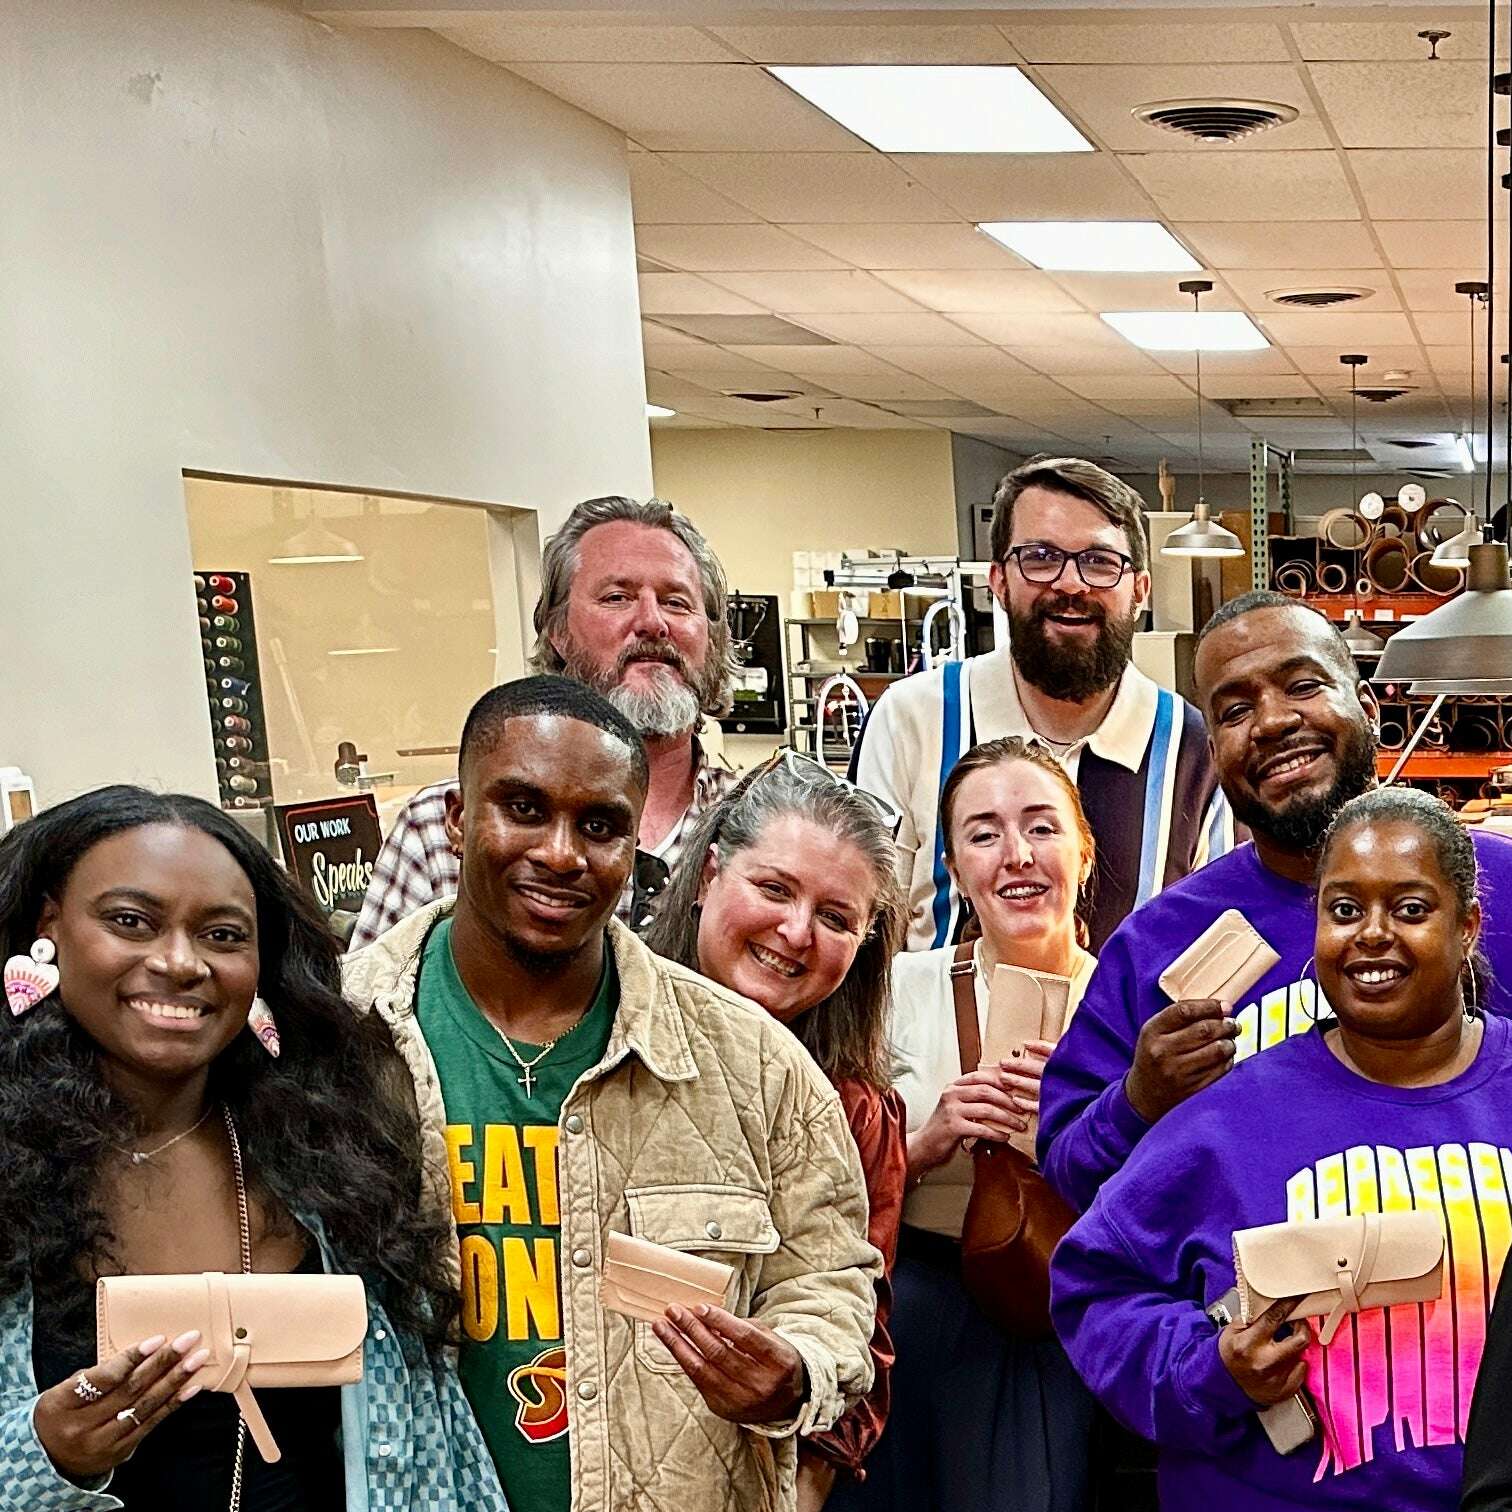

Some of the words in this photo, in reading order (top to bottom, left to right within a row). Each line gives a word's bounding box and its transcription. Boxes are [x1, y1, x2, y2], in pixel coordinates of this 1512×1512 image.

[294, 821, 320, 844] OUR
[320, 817, 352, 838] WORK
[312, 847, 373, 907] Speaks
